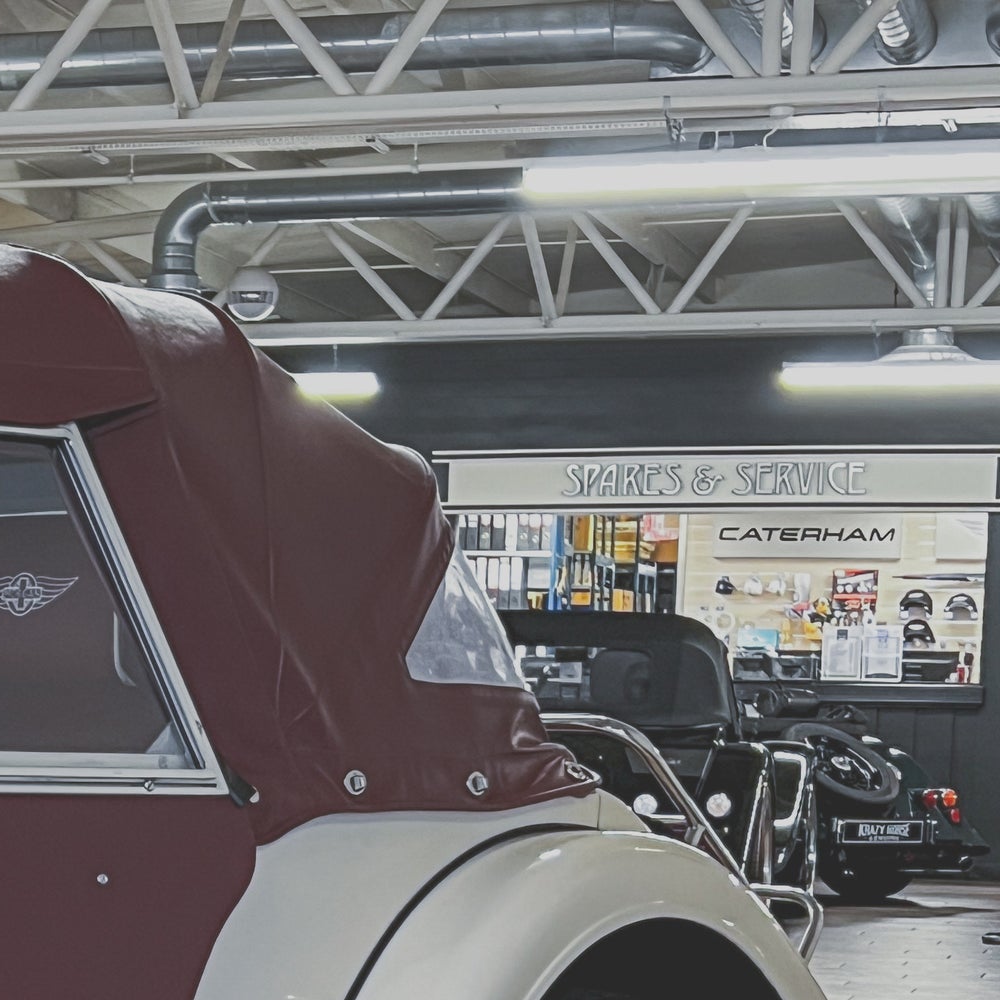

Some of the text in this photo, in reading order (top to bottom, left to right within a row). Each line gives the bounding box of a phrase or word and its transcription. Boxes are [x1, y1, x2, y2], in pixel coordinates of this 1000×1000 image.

[562, 462, 867, 496] SPARES & SERVICE
[719, 527, 896, 542] CATERHAM
